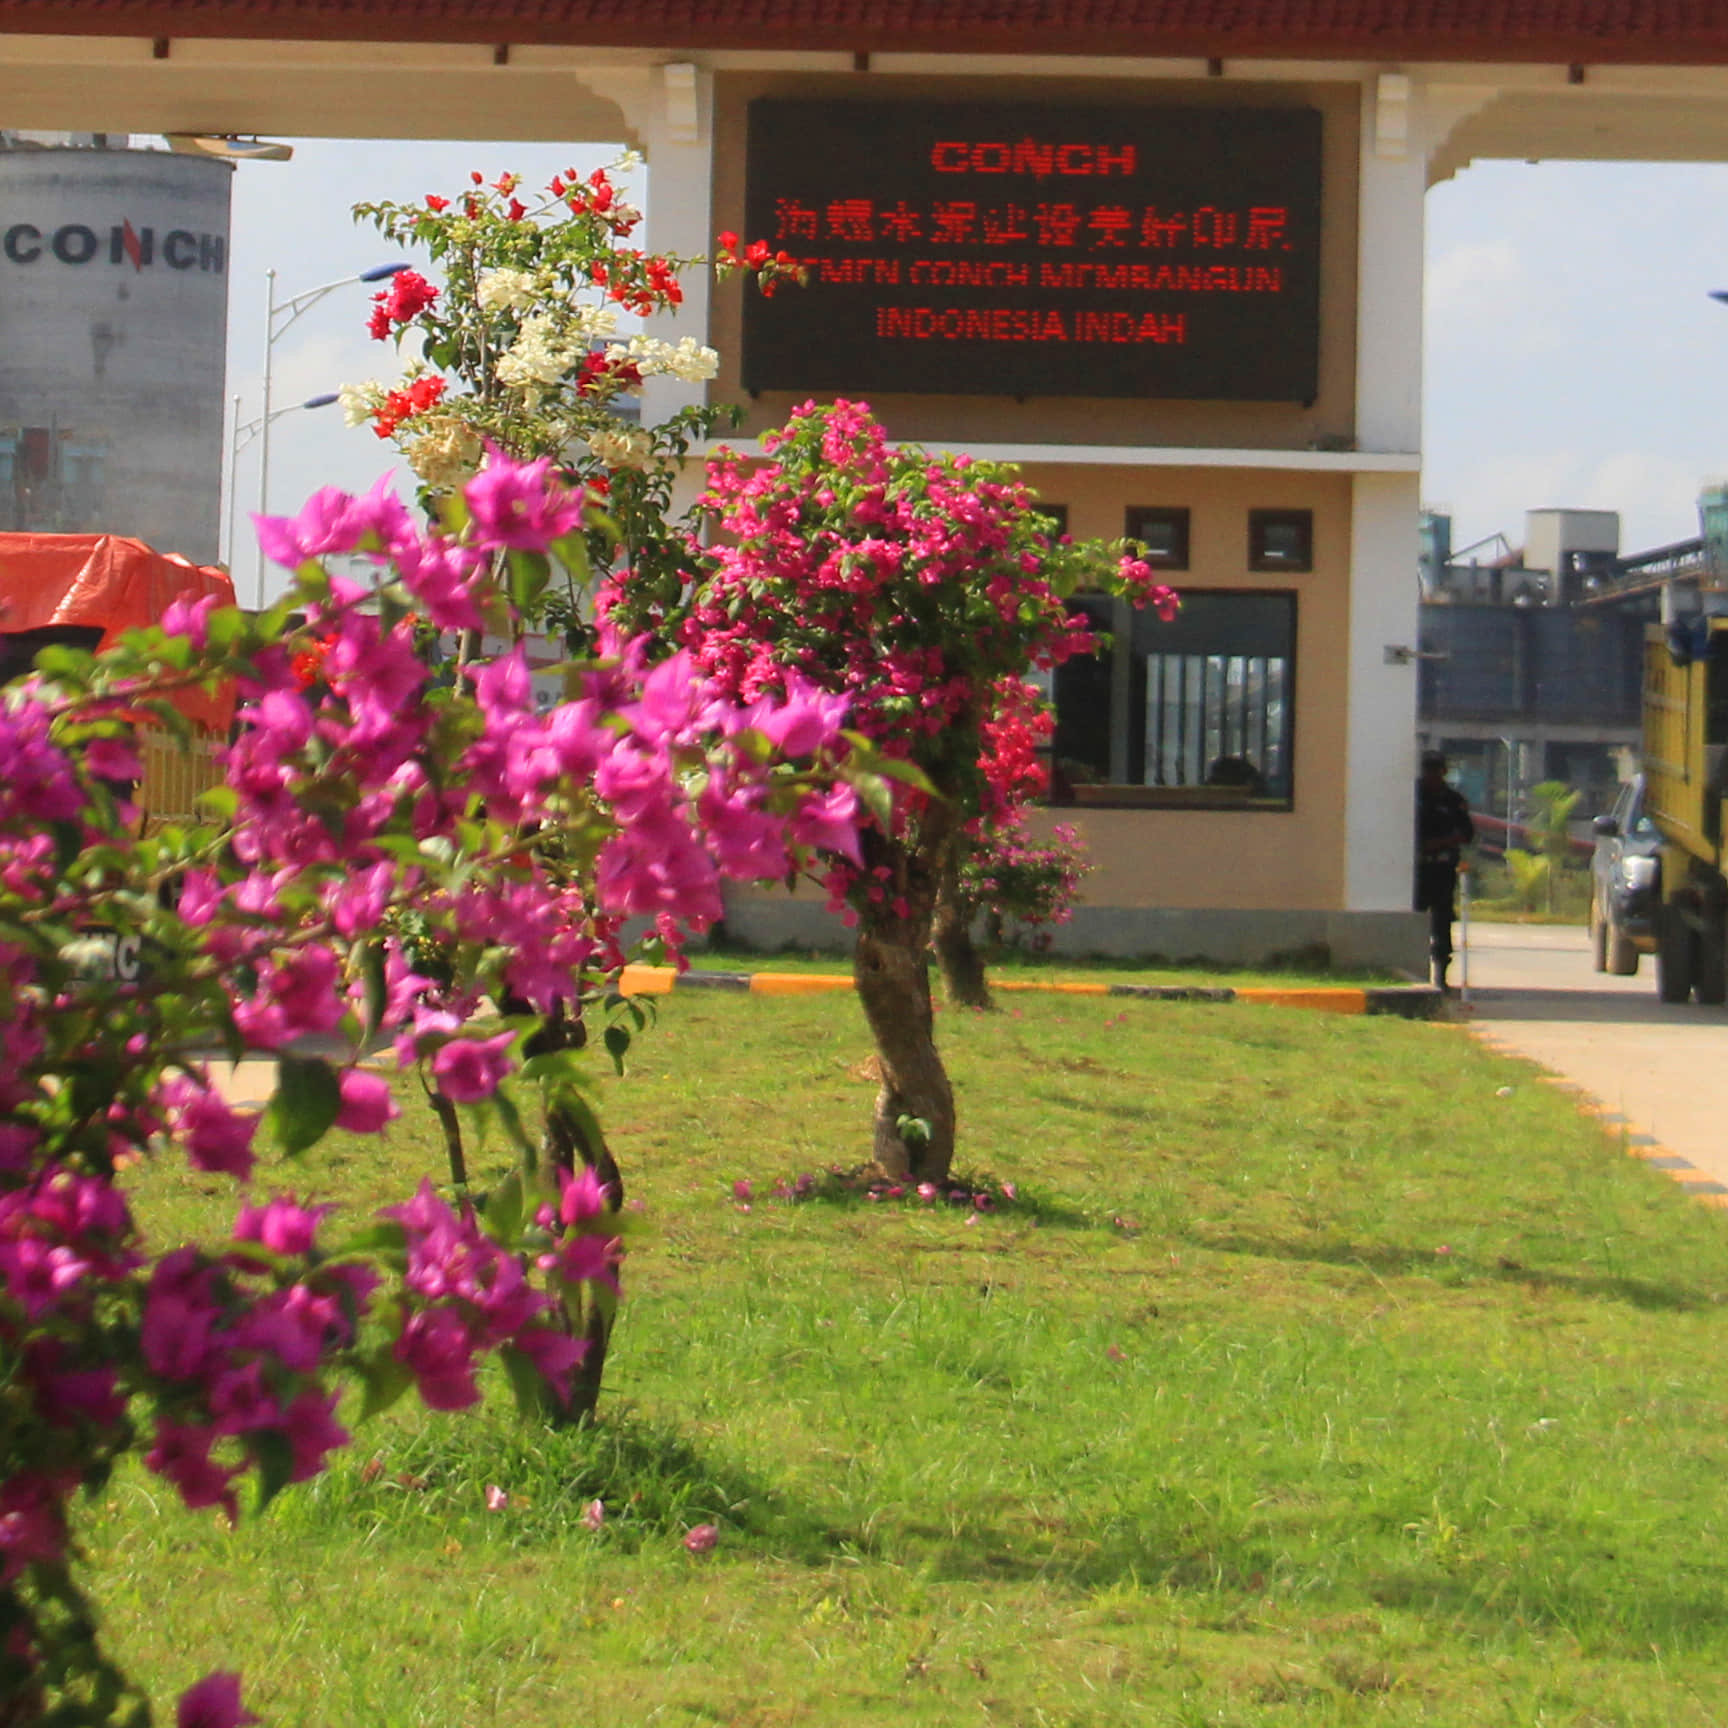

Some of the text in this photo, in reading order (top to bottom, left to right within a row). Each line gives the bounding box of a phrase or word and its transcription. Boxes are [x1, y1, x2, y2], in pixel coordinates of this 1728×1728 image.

[930, 138, 1136, 178] CONCH
[4, 216, 225, 274] CONCH
[909, 260, 1028, 287] CONCH
[875, 307, 1186, 344] INDONESIA INDAH
